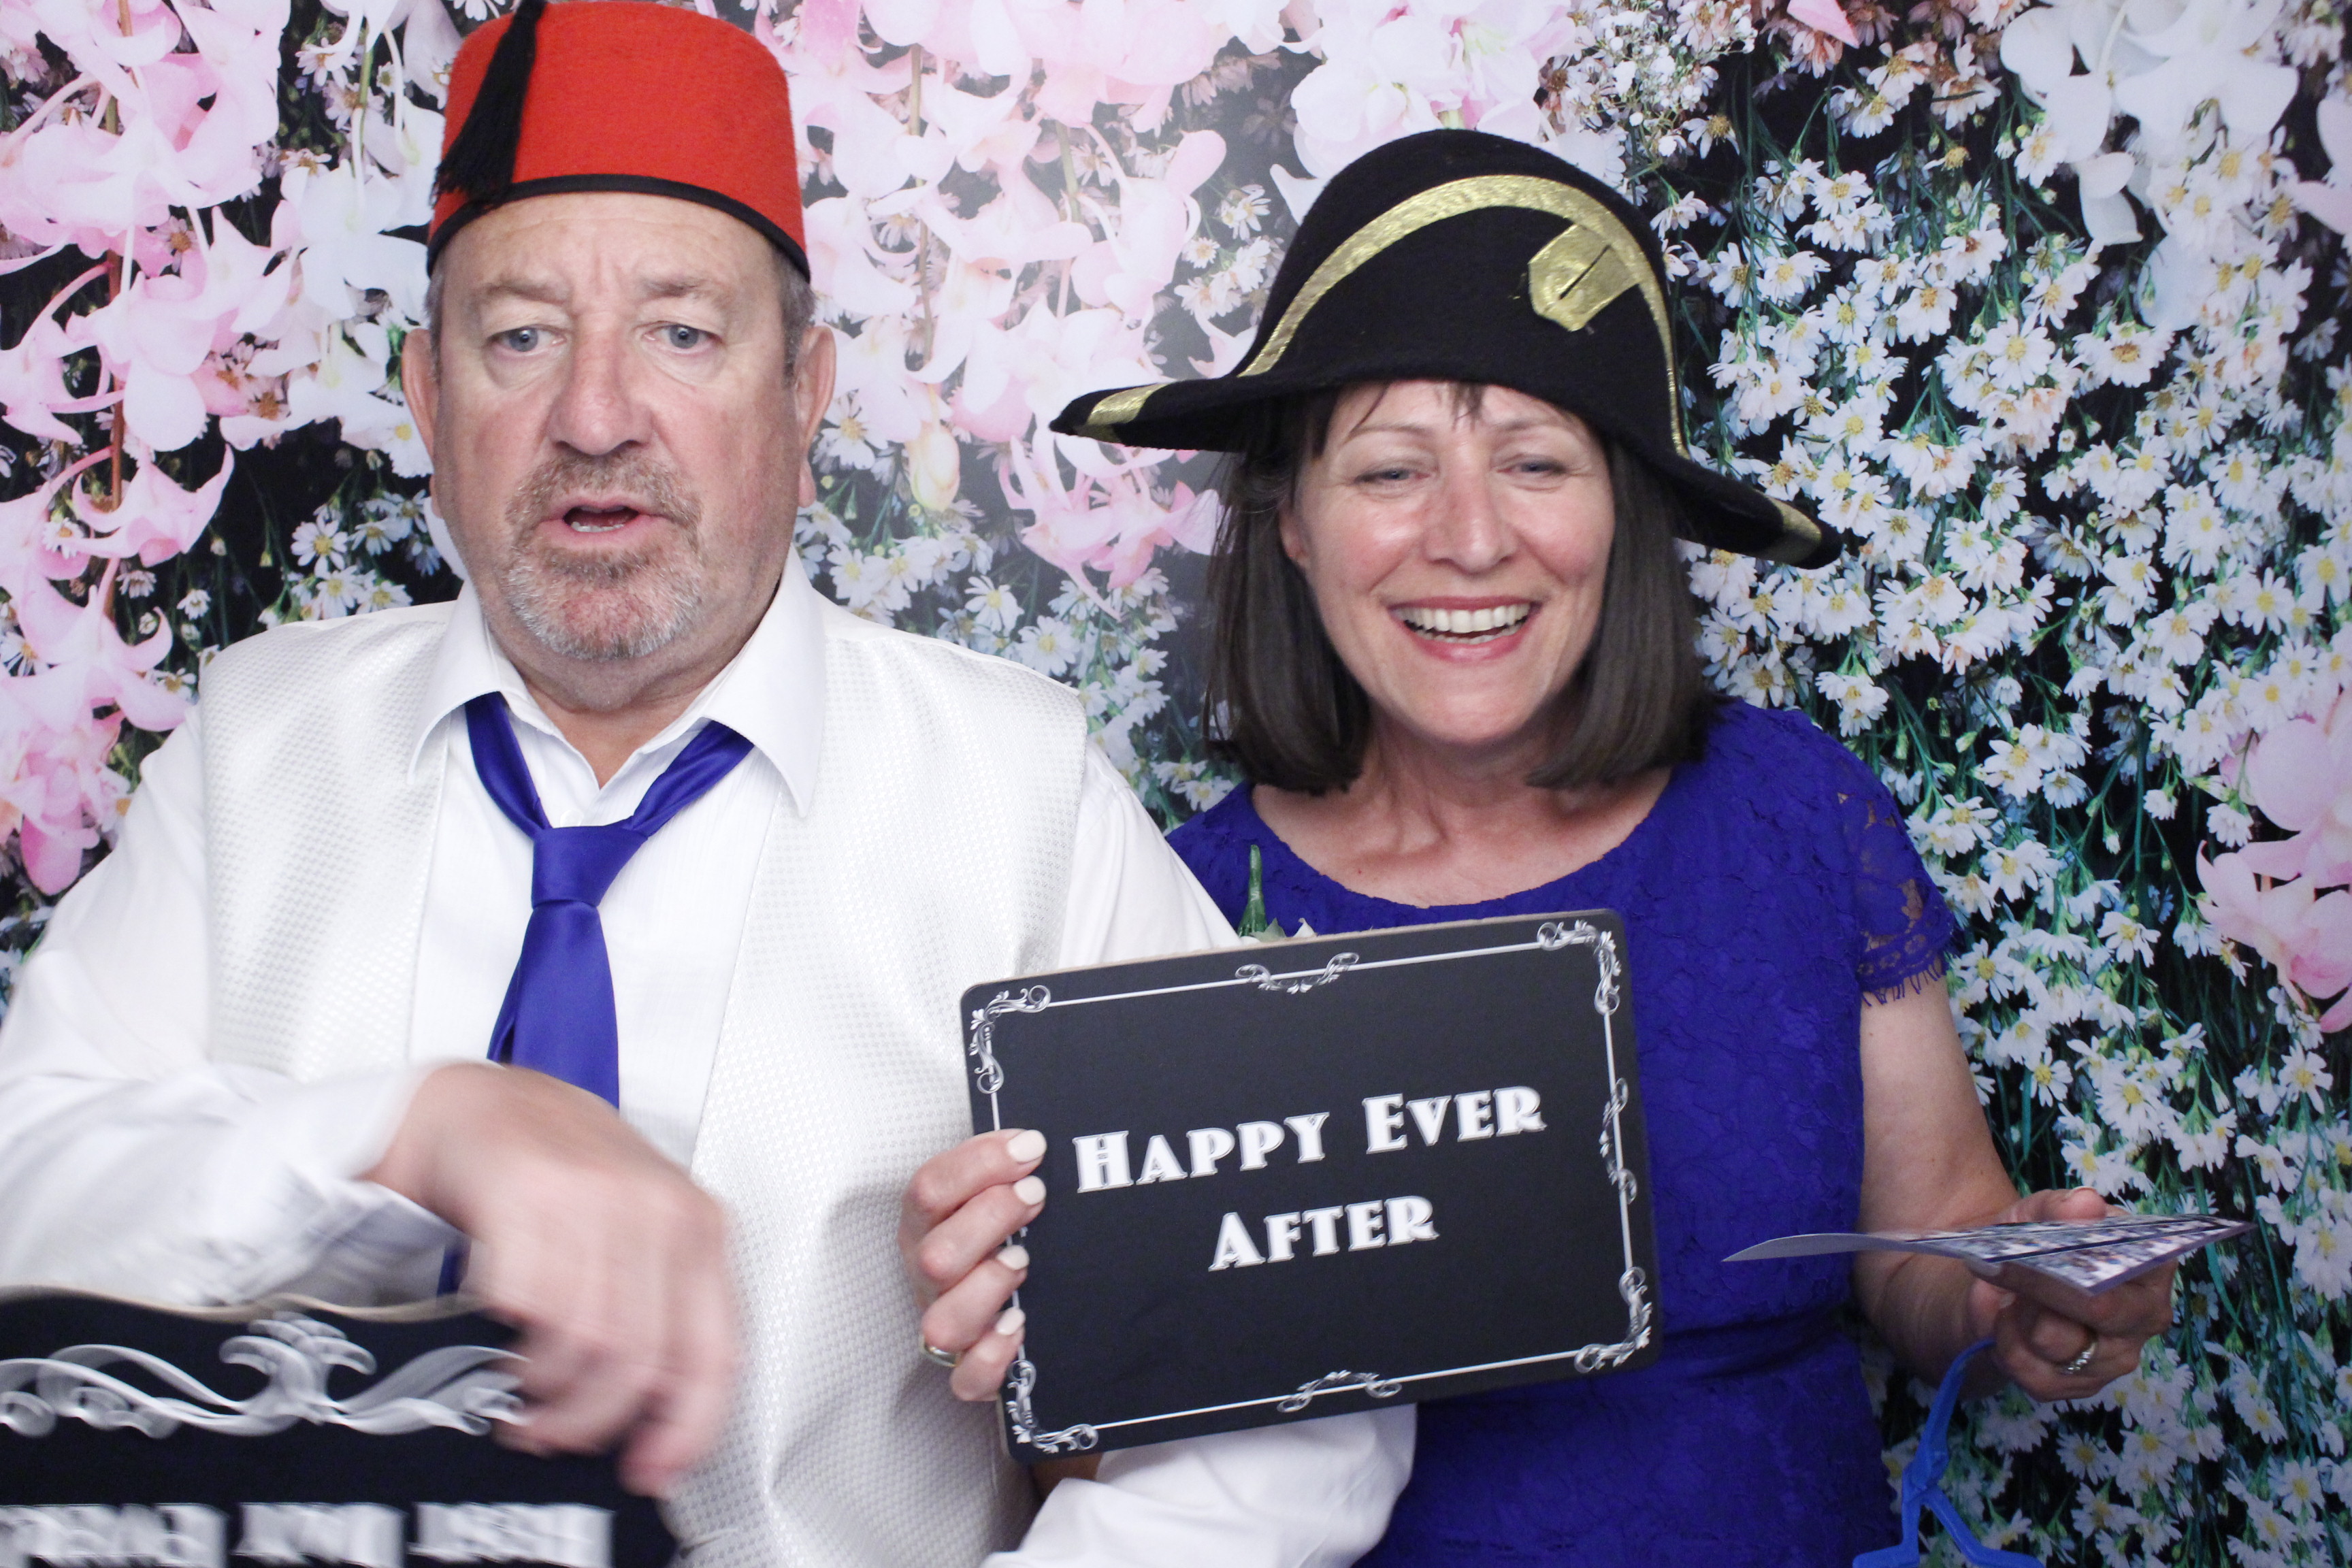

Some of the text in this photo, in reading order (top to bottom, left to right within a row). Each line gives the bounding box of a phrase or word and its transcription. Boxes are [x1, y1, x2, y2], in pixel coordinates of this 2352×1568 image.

[1072, 1085, 1548, 1193] HAPPY EVER
[1208, 1195, 1440, 1271] AFTER
